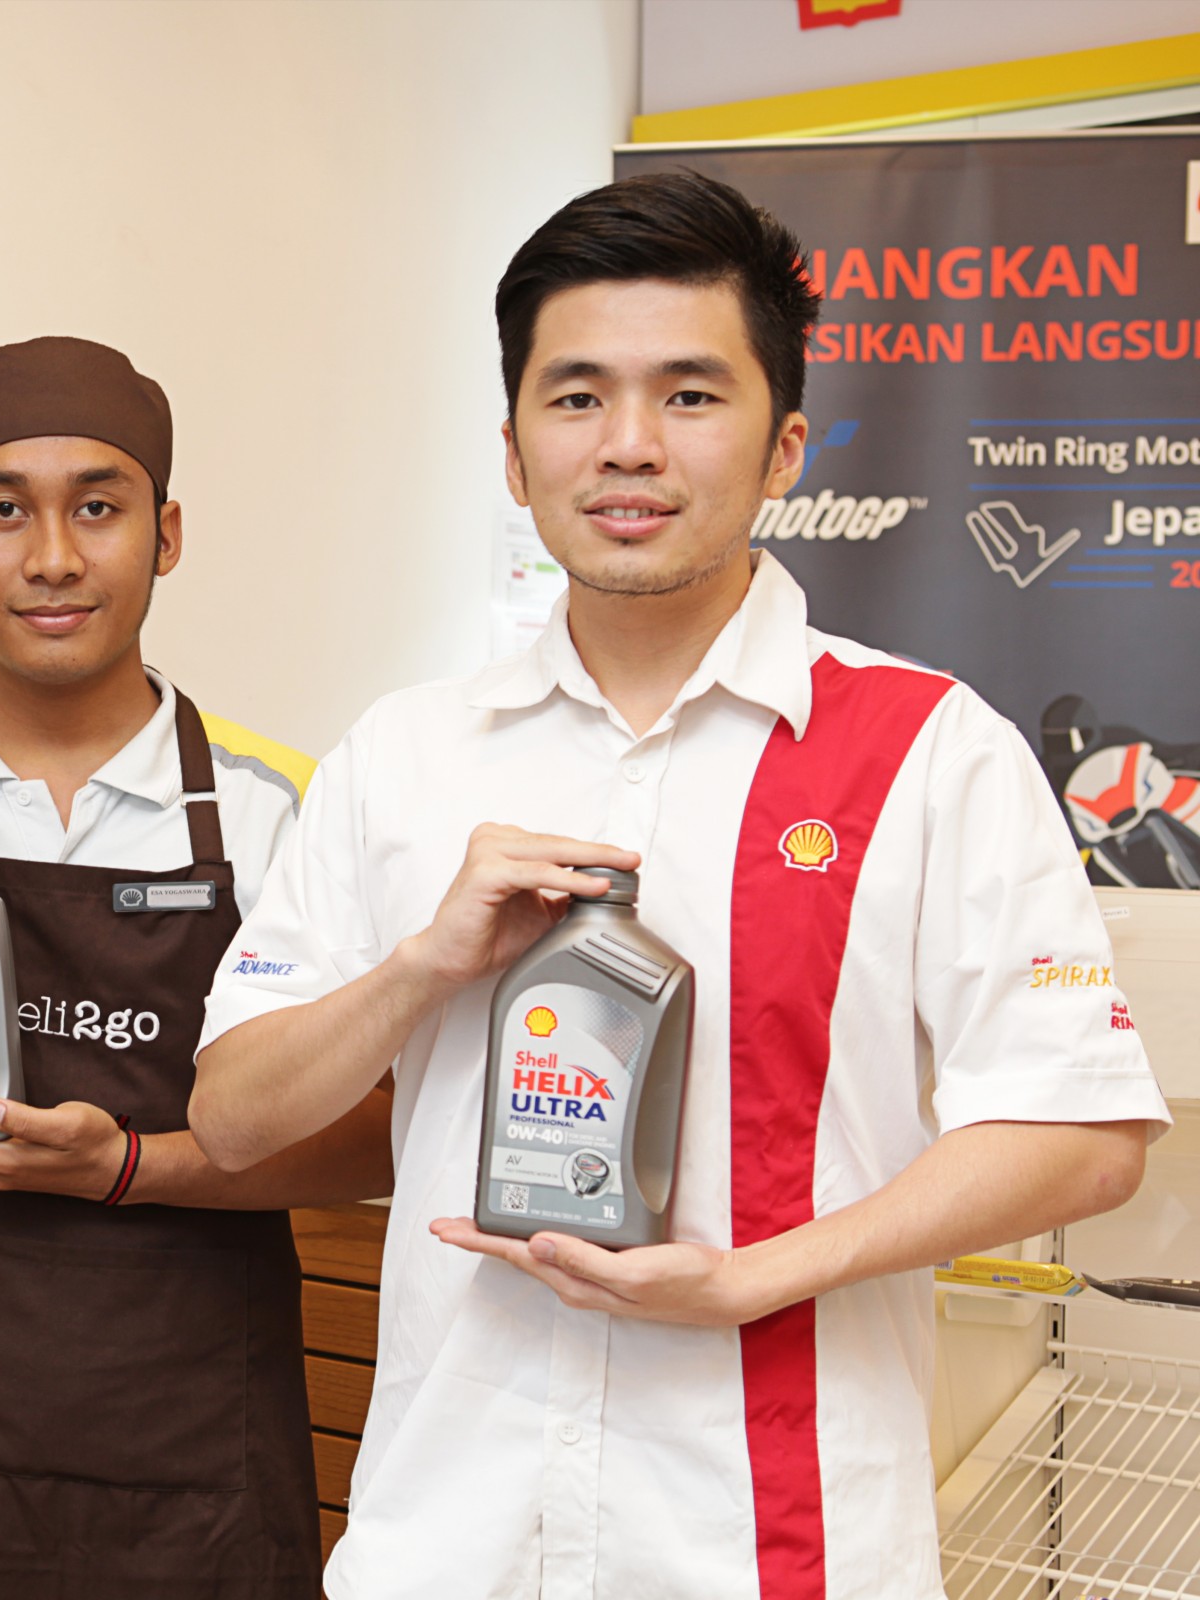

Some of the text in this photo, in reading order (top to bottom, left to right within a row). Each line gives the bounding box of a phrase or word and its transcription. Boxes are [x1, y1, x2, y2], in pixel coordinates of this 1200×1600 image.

[967, 436, 1047, 466] Twin
[1055, 436, 1129, 474] Ring
[240, 951, 258, 959] Shell
[1032, 956, 1052, 965] Shell
[232, 959, 300, 976] ADVANCE
[1030, 965, 1113, 988] SPIRAX
[515, 1051, 558, 1069] Shell
[513, 1068, 612, 1100] HELIX
[512, 1093, 607, 1122] ULTRA
[509, 1115, 575, 1128] PROFESSIONAL
[507, 1124, 563, 1144] 0W-40
[506, 1155, 522, 1165] AV
[603, 1205, 617, 1219] 1L
